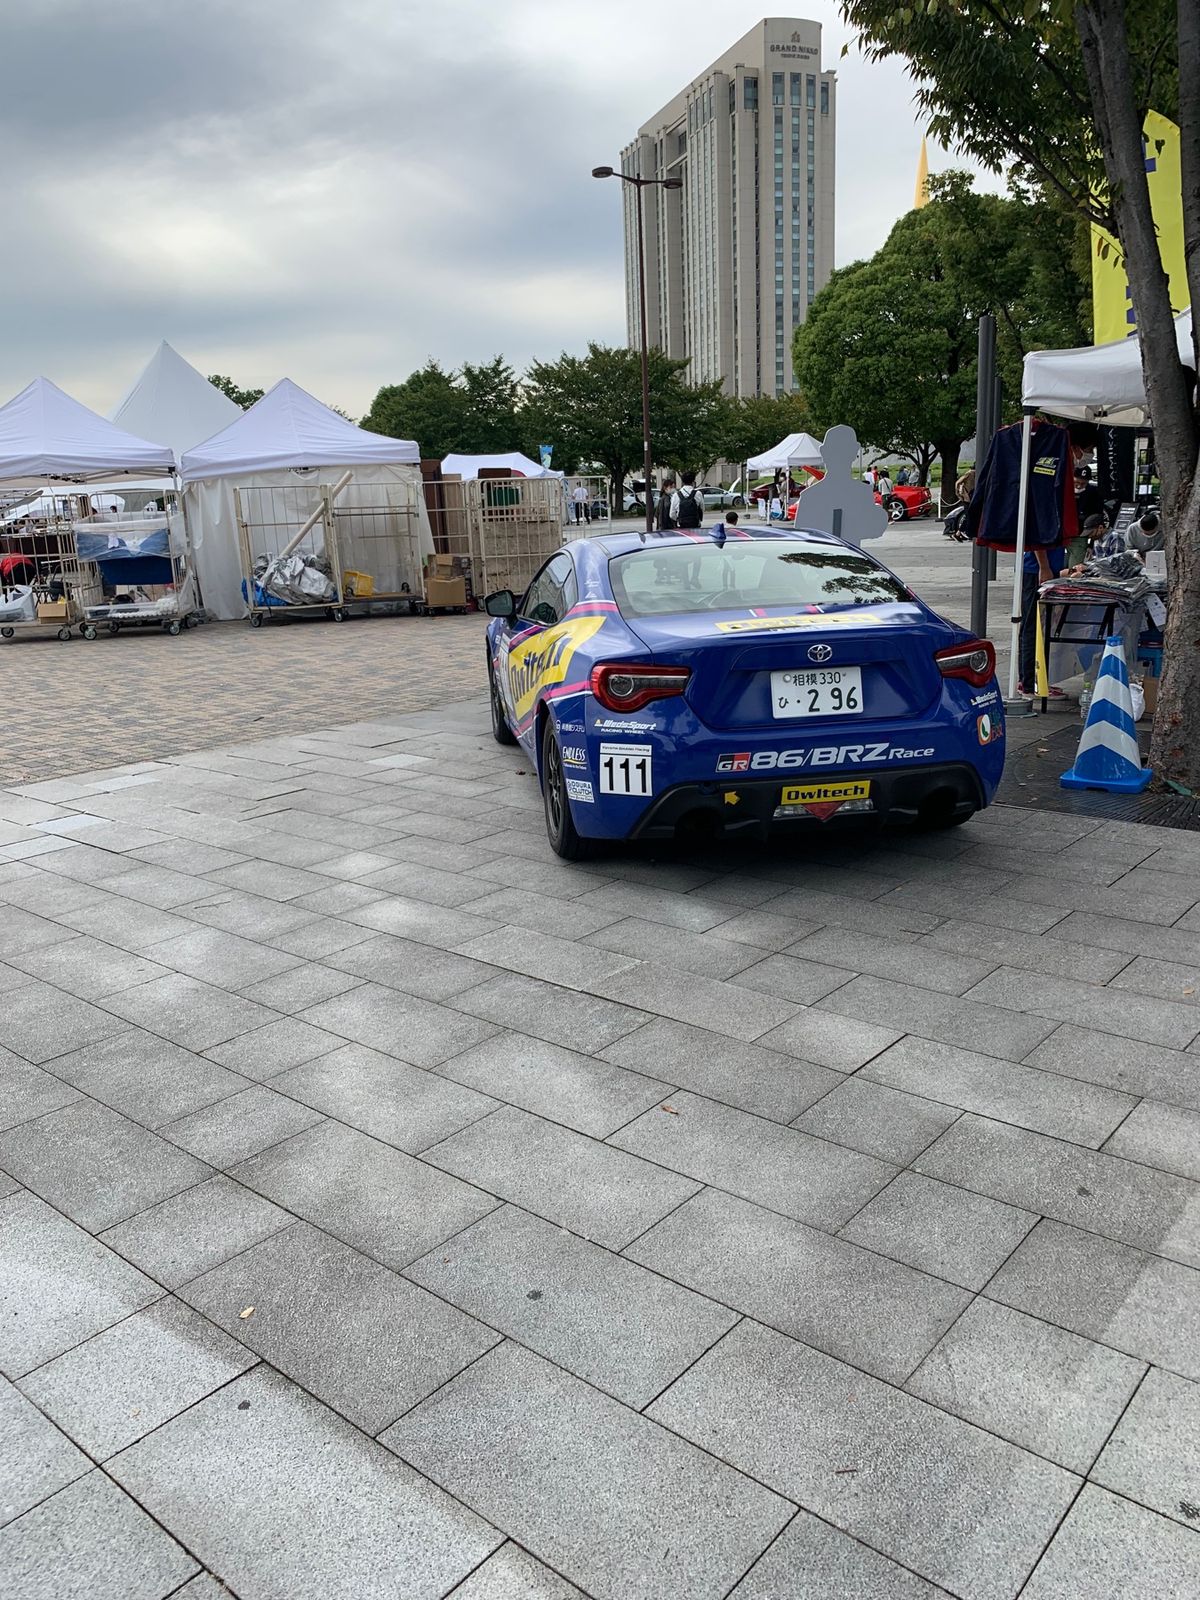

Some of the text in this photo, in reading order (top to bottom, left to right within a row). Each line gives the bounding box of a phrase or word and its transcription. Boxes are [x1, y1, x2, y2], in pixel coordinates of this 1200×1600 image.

[770, 44, 819, 55] GRAND NIKKO
[602, 719, 657, 730] WedsSport
[562, 746, 586, 761] ENDLESS
[718, 742, 935, 771] GR 86/BRZ Race
[603, 756, 647, 793] 111
[786, 784, 865, 801] Owltech
